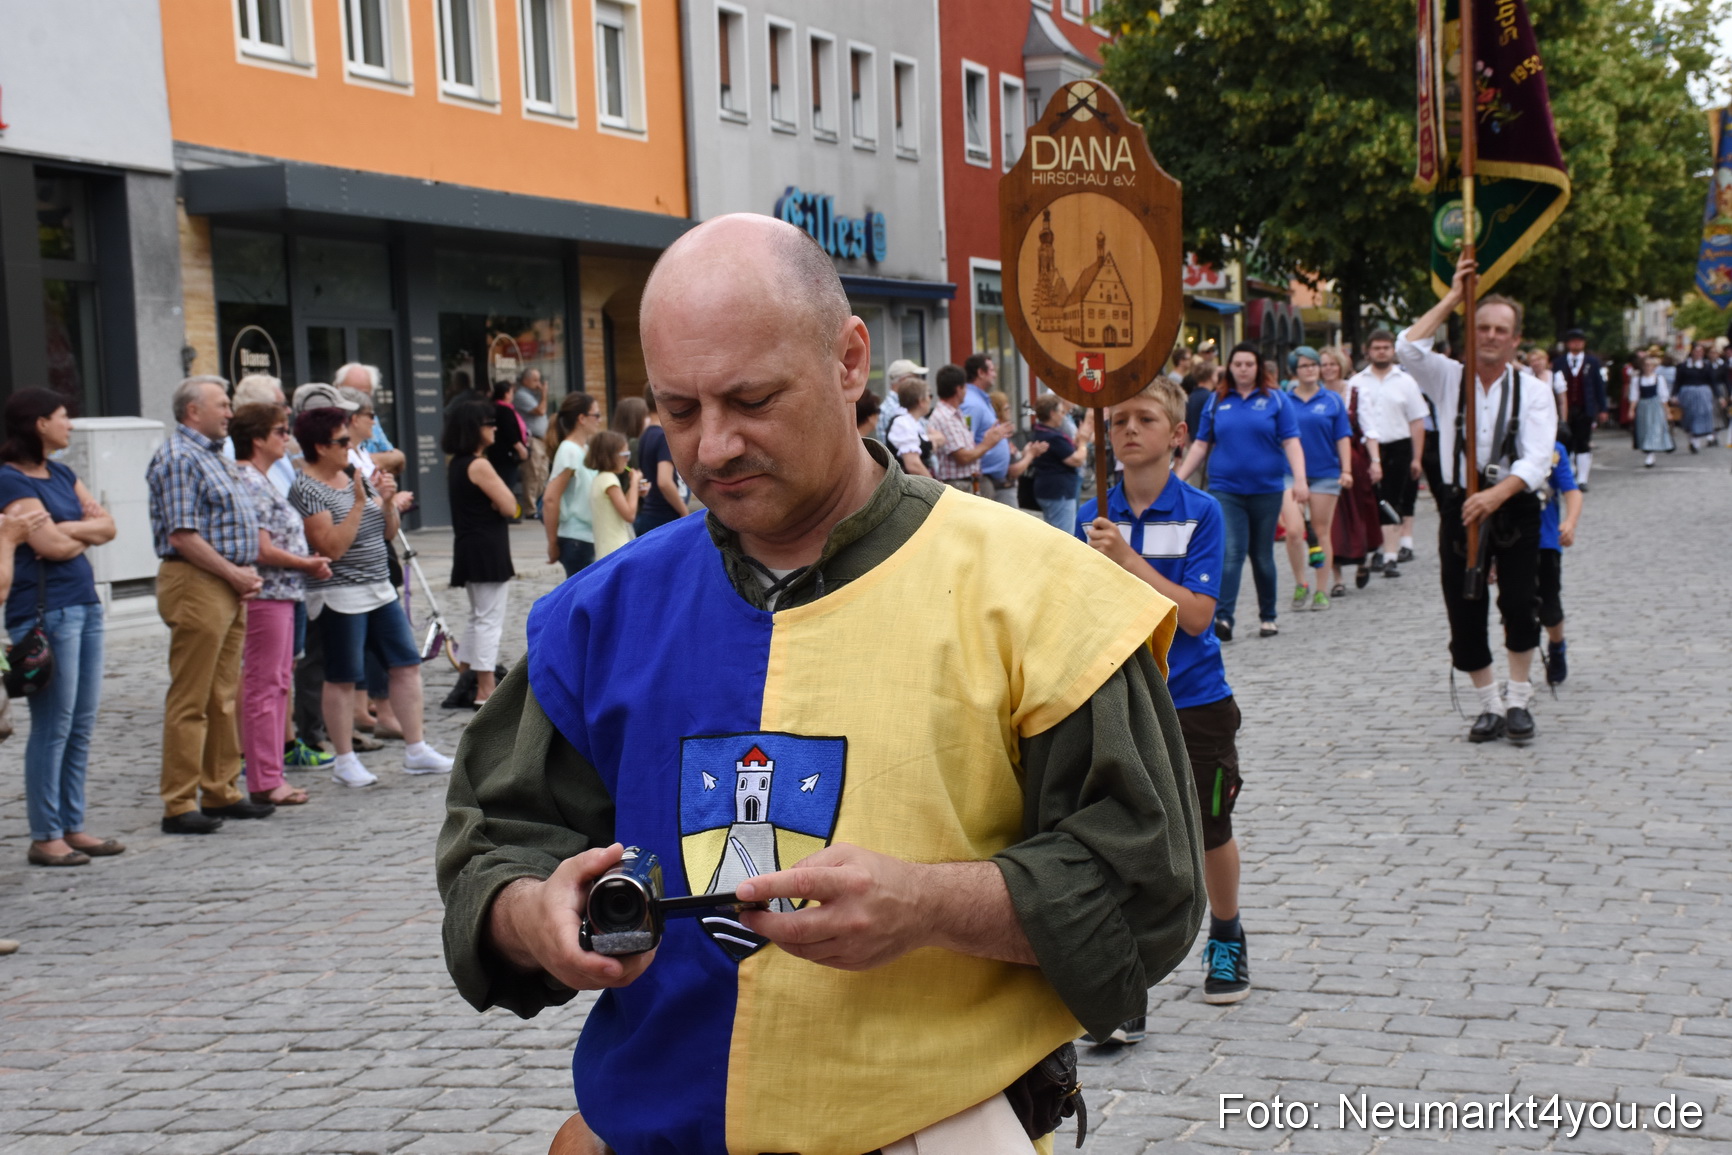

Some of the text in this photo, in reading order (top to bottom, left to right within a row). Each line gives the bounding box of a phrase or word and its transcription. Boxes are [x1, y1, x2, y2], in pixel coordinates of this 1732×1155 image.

[1031, 135, 1136, 171] DIANA
[1032, 172, 1136, 187] HIRSCHAU e.V.
